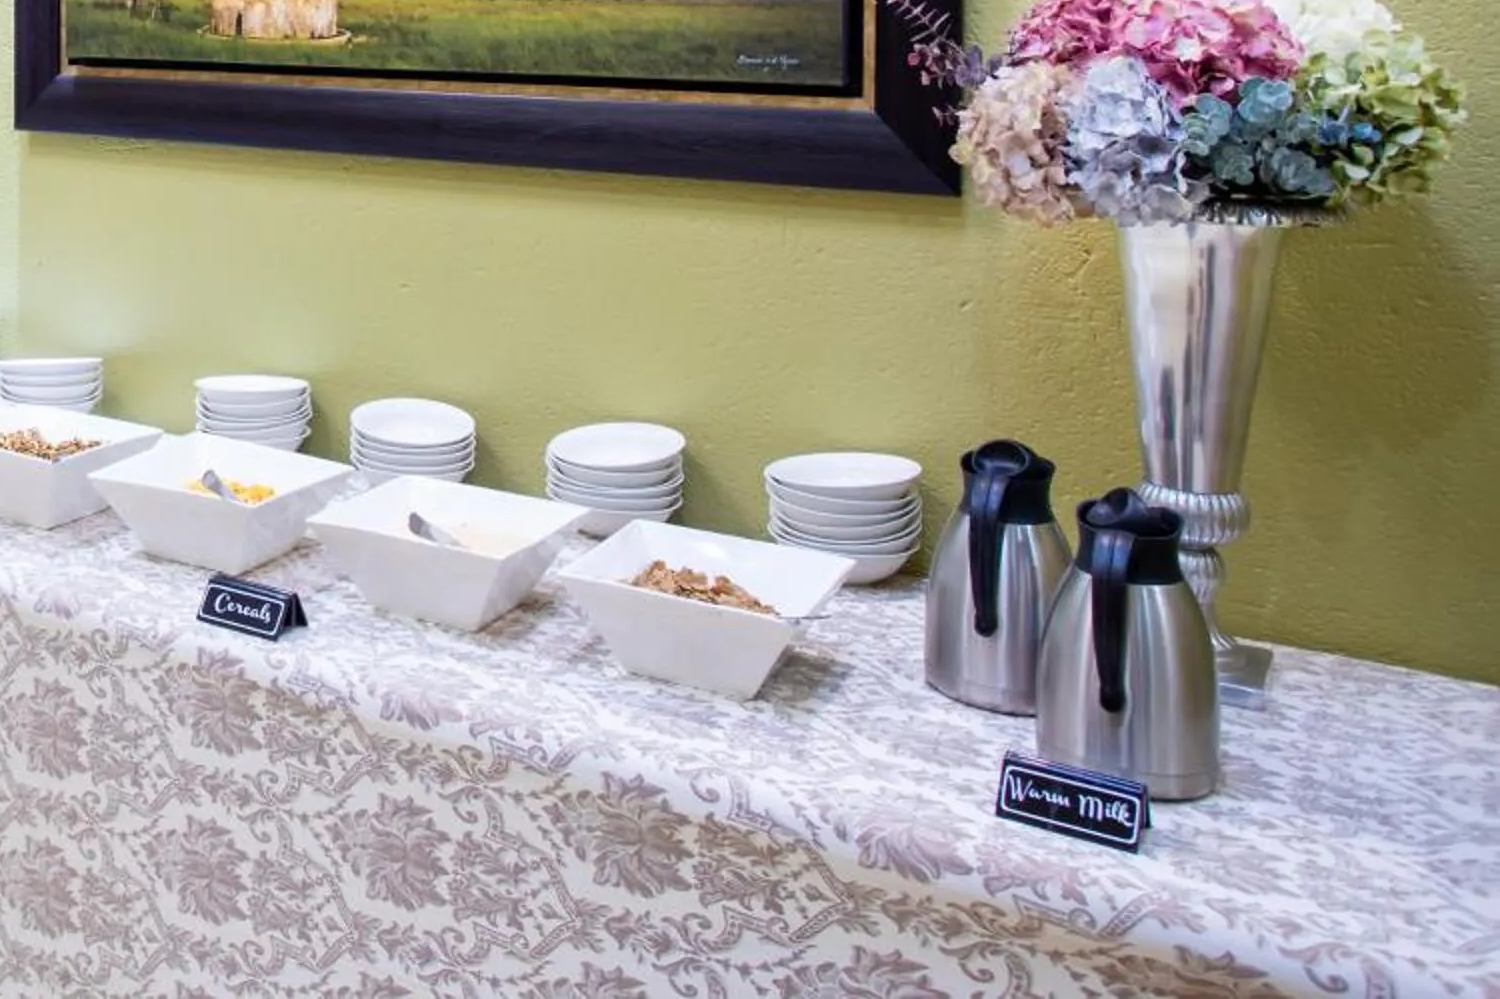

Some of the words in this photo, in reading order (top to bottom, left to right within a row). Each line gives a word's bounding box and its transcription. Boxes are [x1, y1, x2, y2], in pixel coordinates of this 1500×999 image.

[214, 592, 271, 624] Cereals
[1007, 774, 1070, 808] Warm
[1078, 794, 1134, 827] Milk
